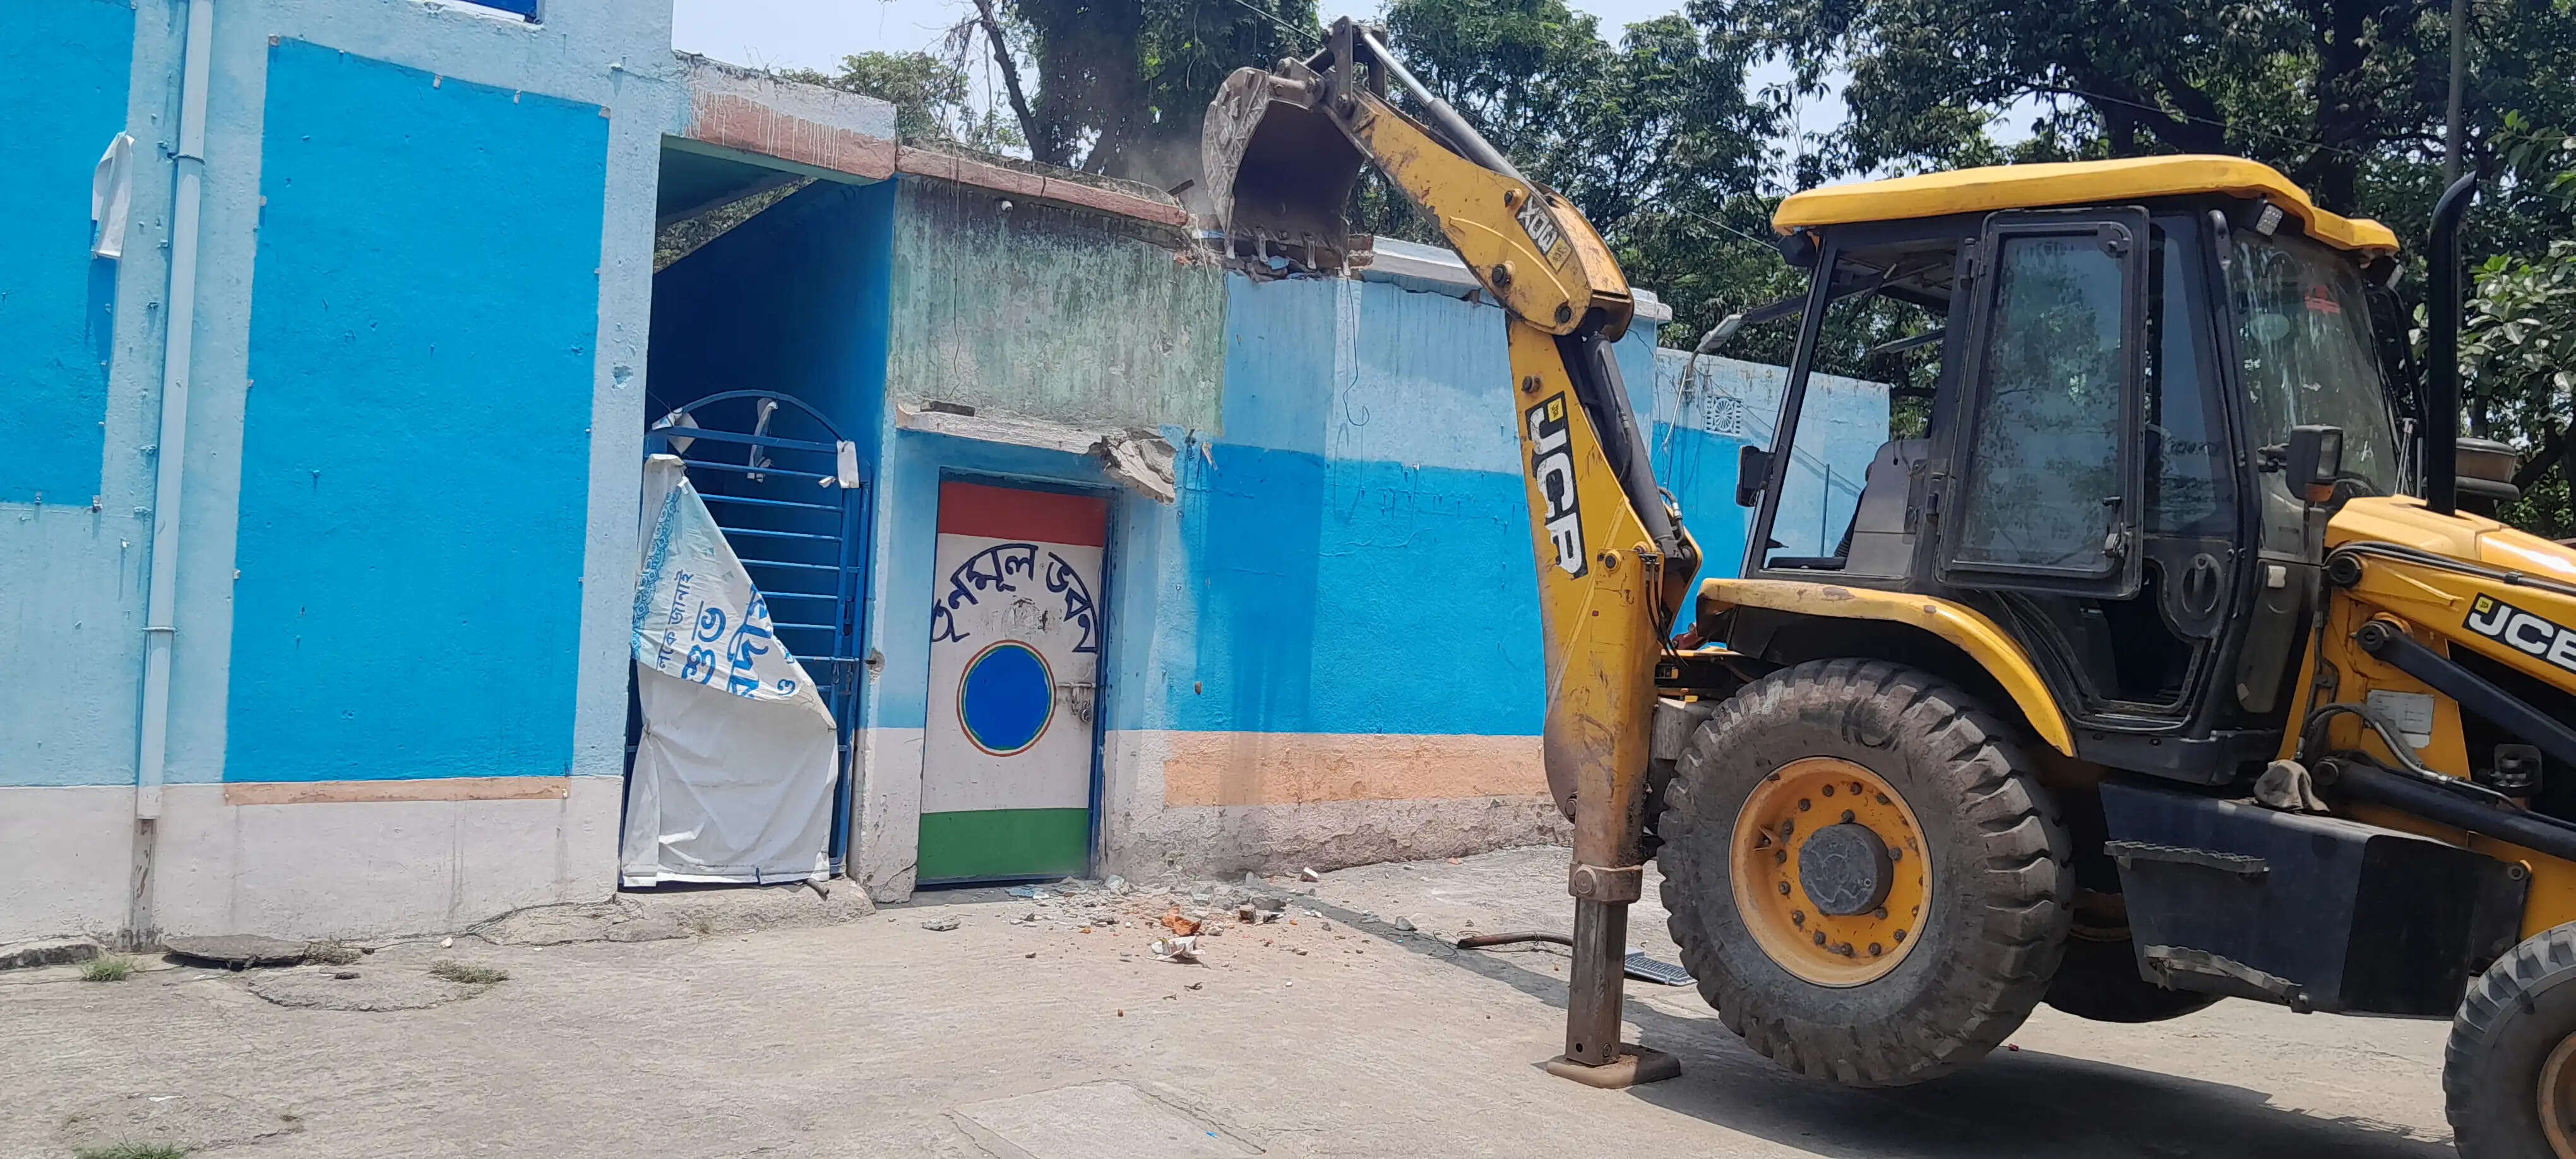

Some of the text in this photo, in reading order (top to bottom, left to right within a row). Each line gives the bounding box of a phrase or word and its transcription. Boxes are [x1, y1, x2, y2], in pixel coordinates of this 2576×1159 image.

[667, 569, 695, 625] জানাই
[1045, 551, 1099, 654] ভবন
[681, 600, 727, 686] শুভ
